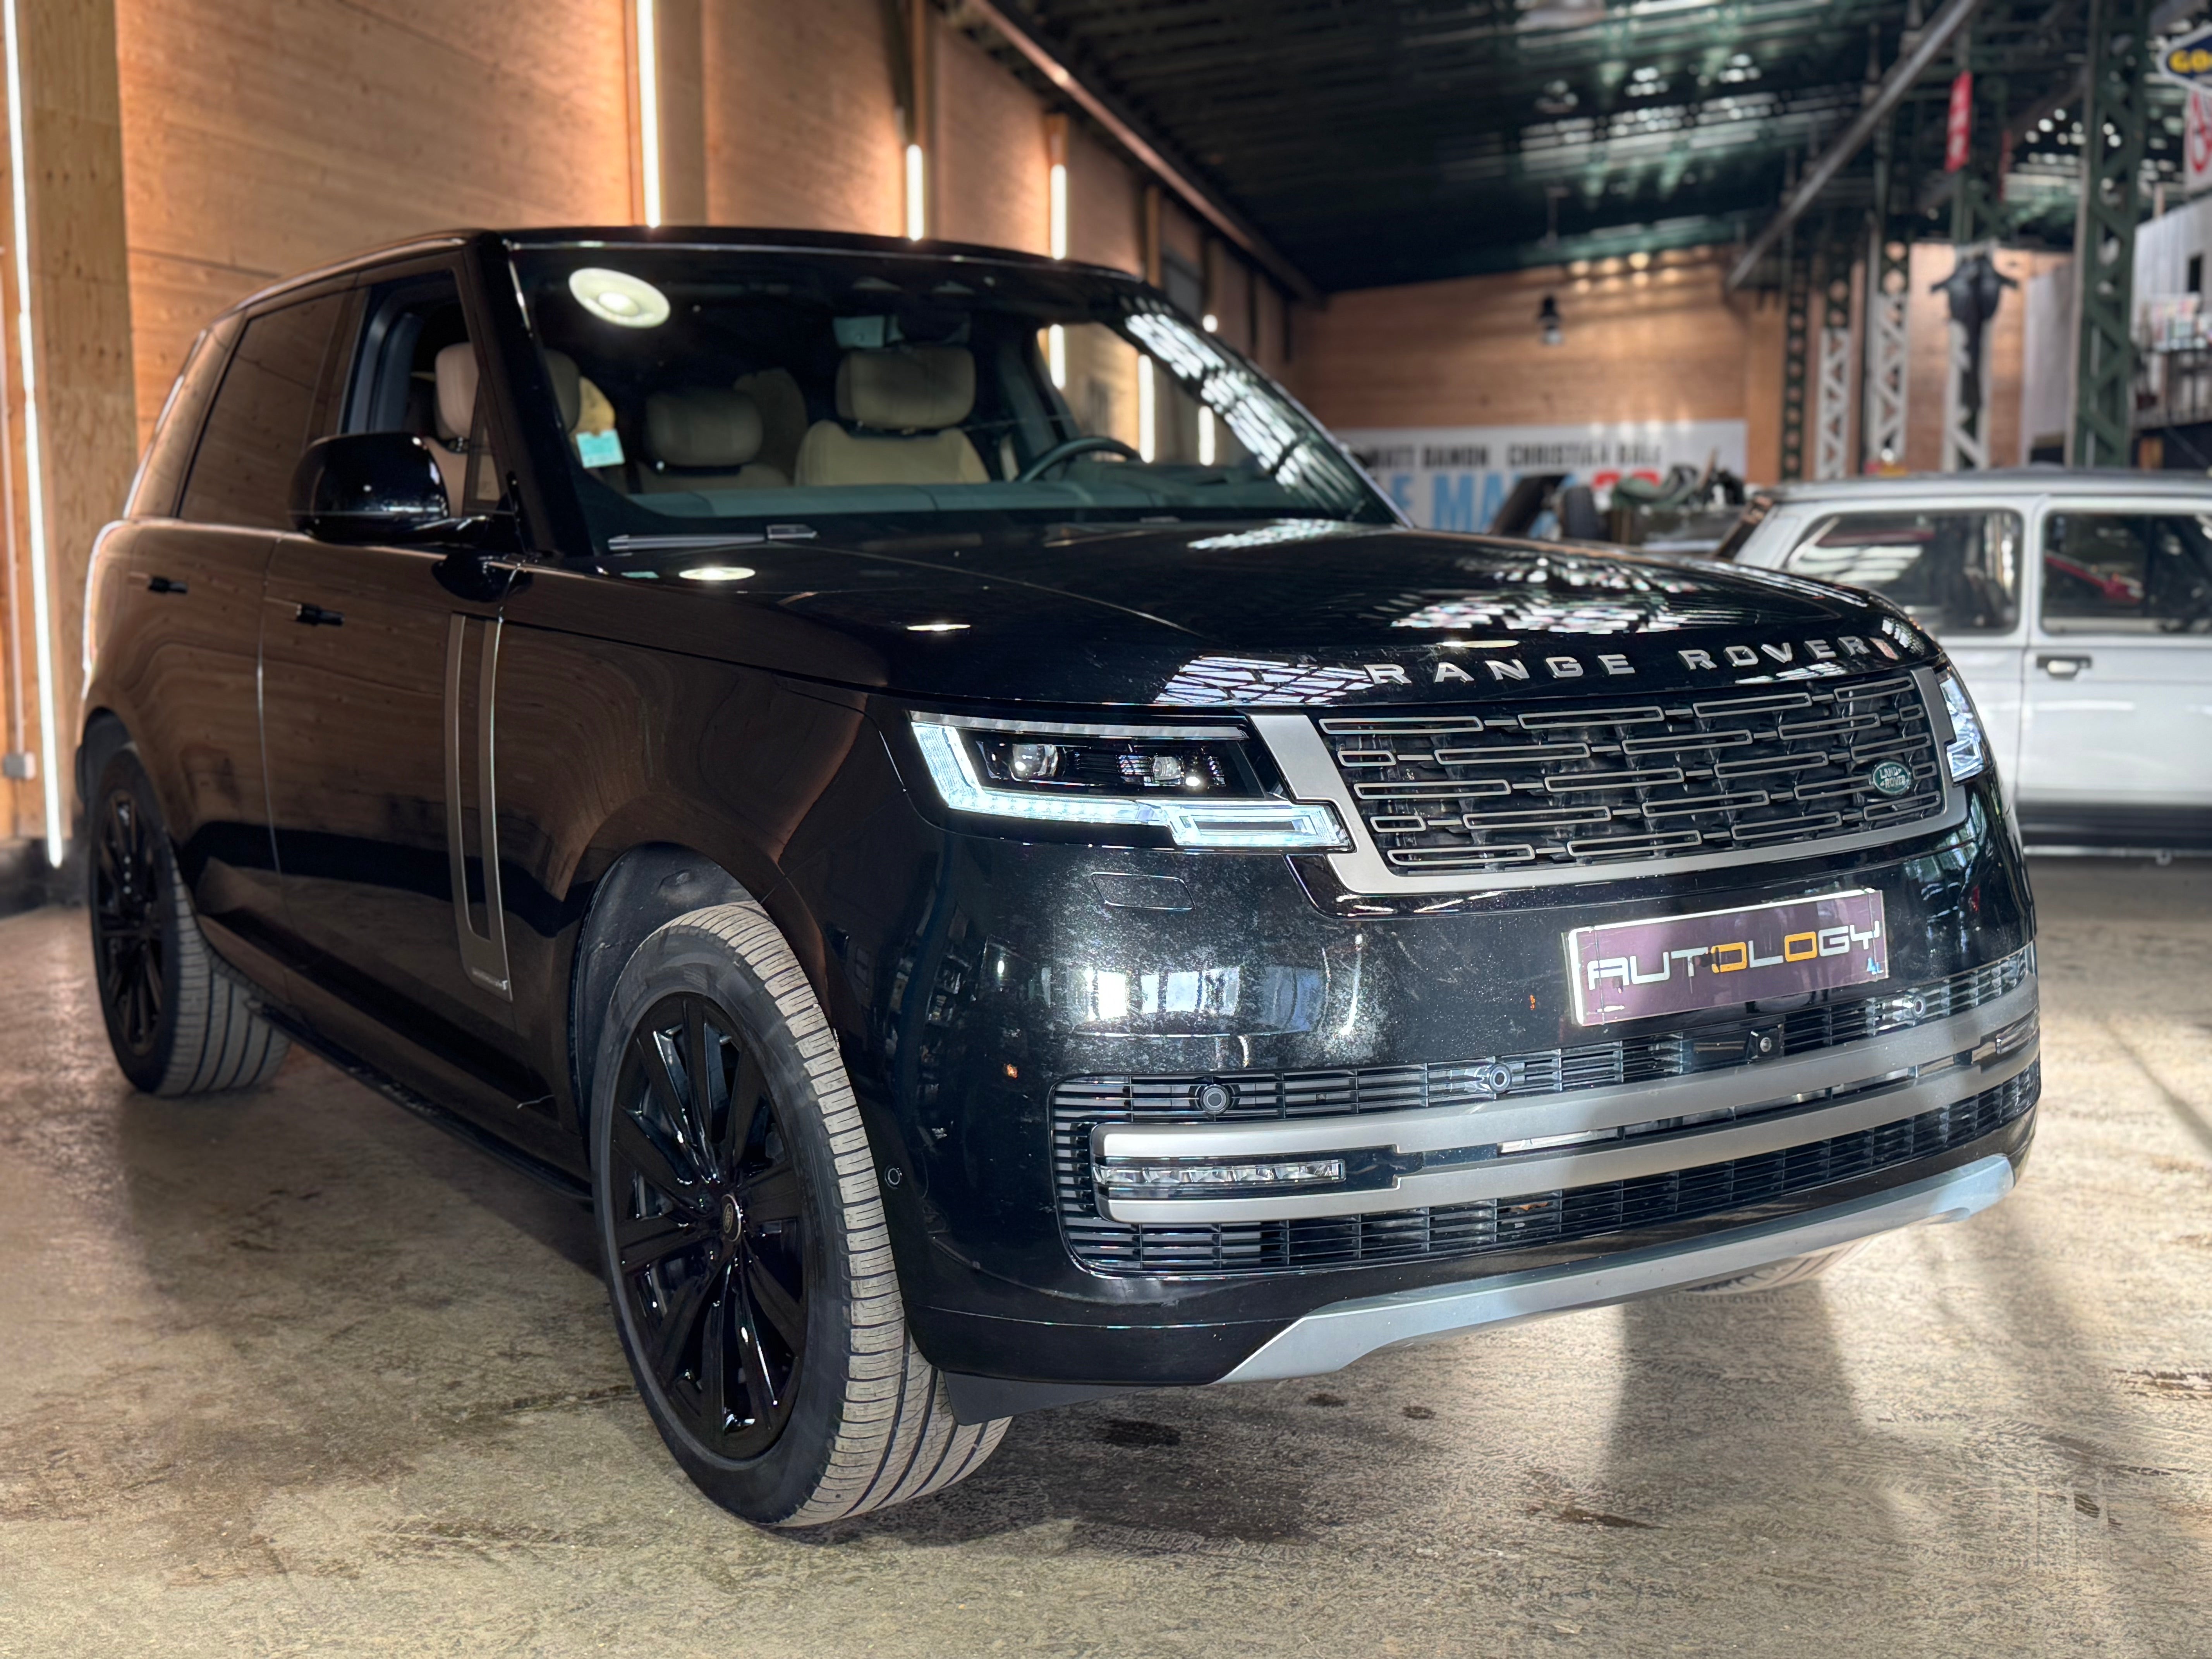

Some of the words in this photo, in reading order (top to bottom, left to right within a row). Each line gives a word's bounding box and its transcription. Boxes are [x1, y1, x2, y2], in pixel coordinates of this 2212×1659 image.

[1364, 654, 1635, 685] RANGE
[1678, 635, 1870, 671] ROVER
[1879, 767, 1899, 779] LAND
[1884, 775, 1906, 788] ROVER
[1587, 920, 1880, 990] AUTOLOGY
